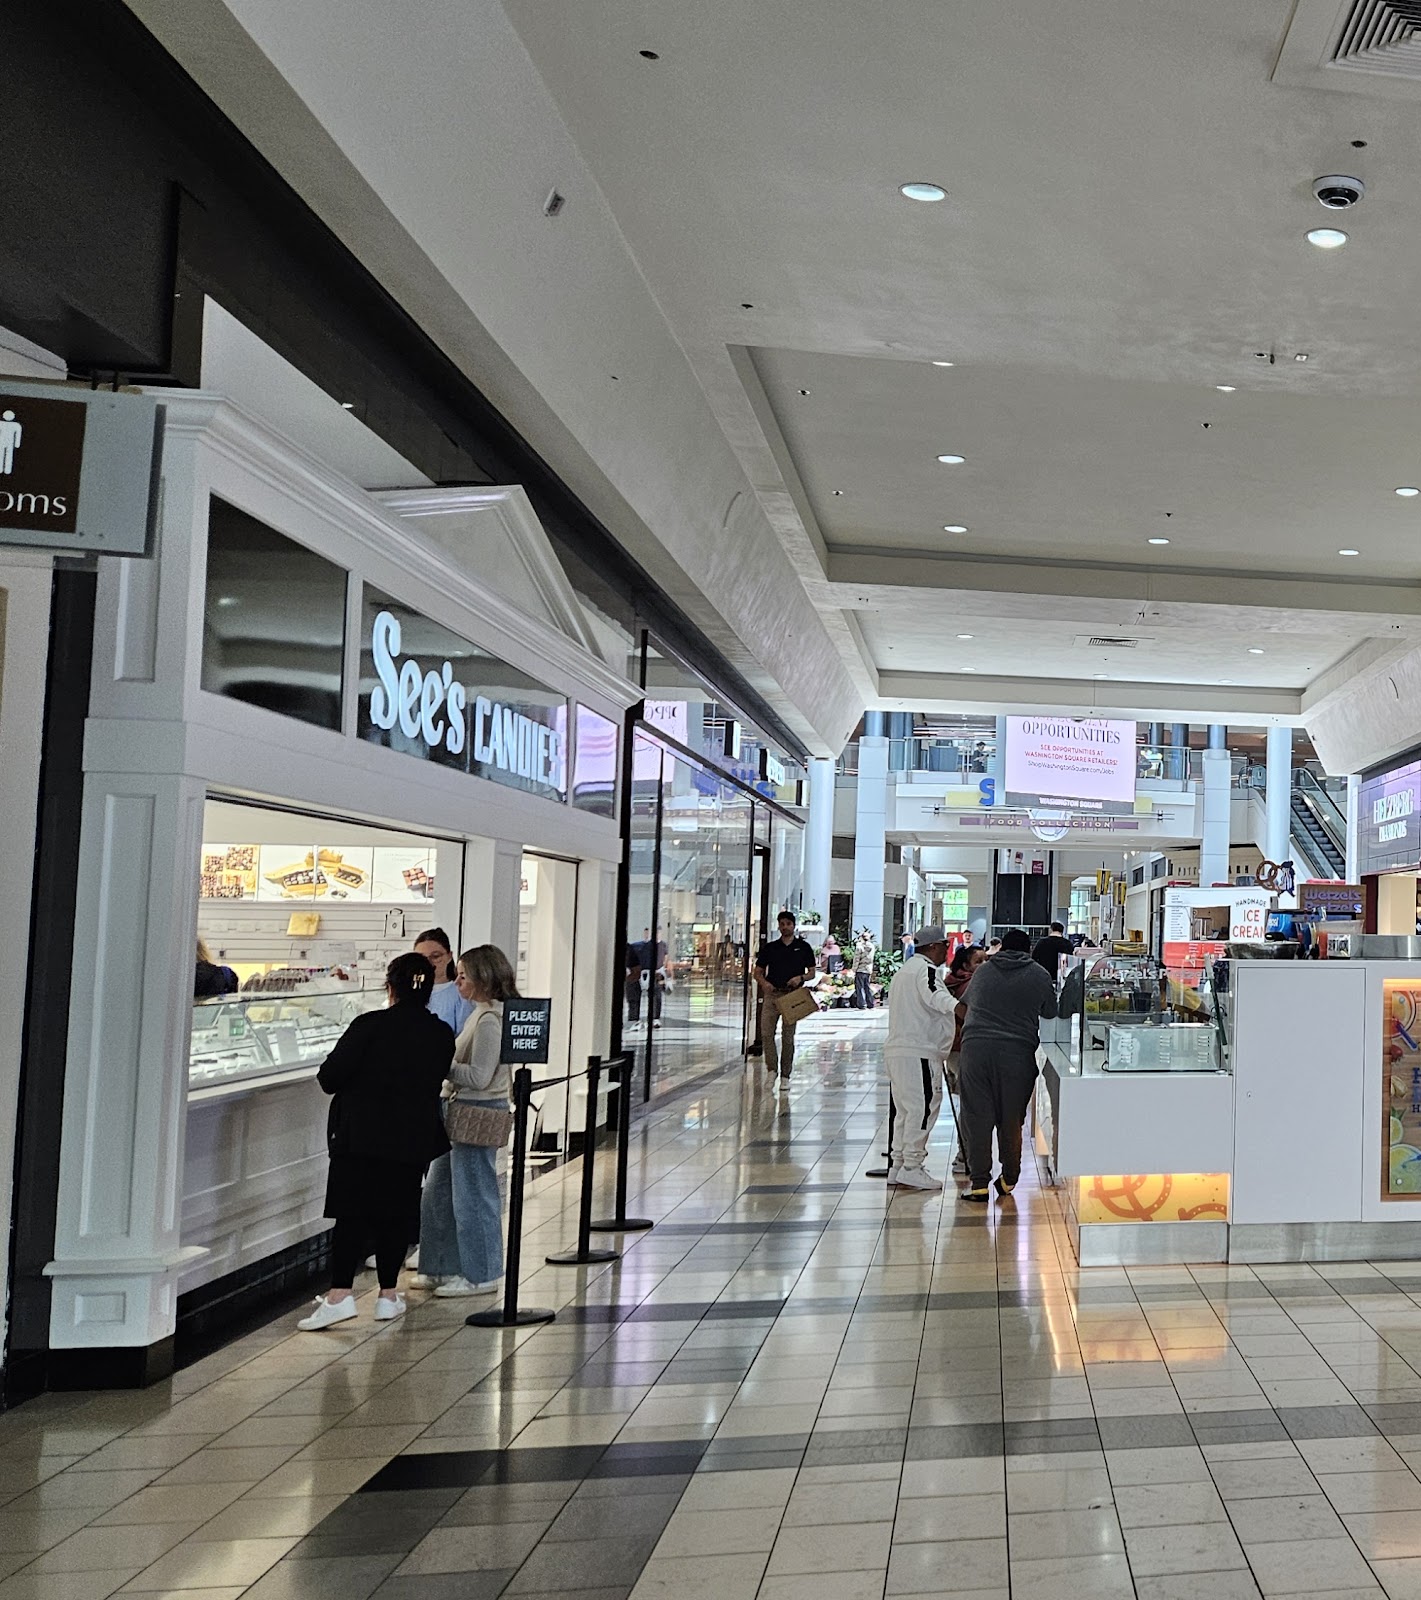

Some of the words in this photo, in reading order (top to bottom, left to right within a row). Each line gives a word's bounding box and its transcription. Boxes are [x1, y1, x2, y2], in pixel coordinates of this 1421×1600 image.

[370, 610, 465, 754] See's
[474, 695, 561, 789] CANDIES
[1022, 720, 1121, 744] OPPORTUNITIES
[1052, 745, 1096, 756] OPPORTUNITIES
[1024, 751, 1063, 760] WASHINGTON
[1064, 755, 1087, 763] SQUARE
[1039, 797, 1079, 808] WASHINGTON
[1079, 800, 1103, 809] SQUARE
[1373, 788, 1415, 824] HELZBERG
[990, 818, 1023, 826] FOOD
[1030, 819, 1111, 829] COLLECTION
[1378, 819, 1408, 843] DIAMONDS
[1304, 888, 1362, 900] Wetzel's
[1235, 897, 1267, 908] HANDMADE
[1304, 901, 1362, 914] Prtzels
[1243, 909, 1260, 922] ICE
[1100, 968, 1156, 980] Wetzel's
[509, 1010, 546, 1022] PLEASE
[510, 1024, 541, 1036] ENTER
[512, 1038, 539, 1050] HERE
